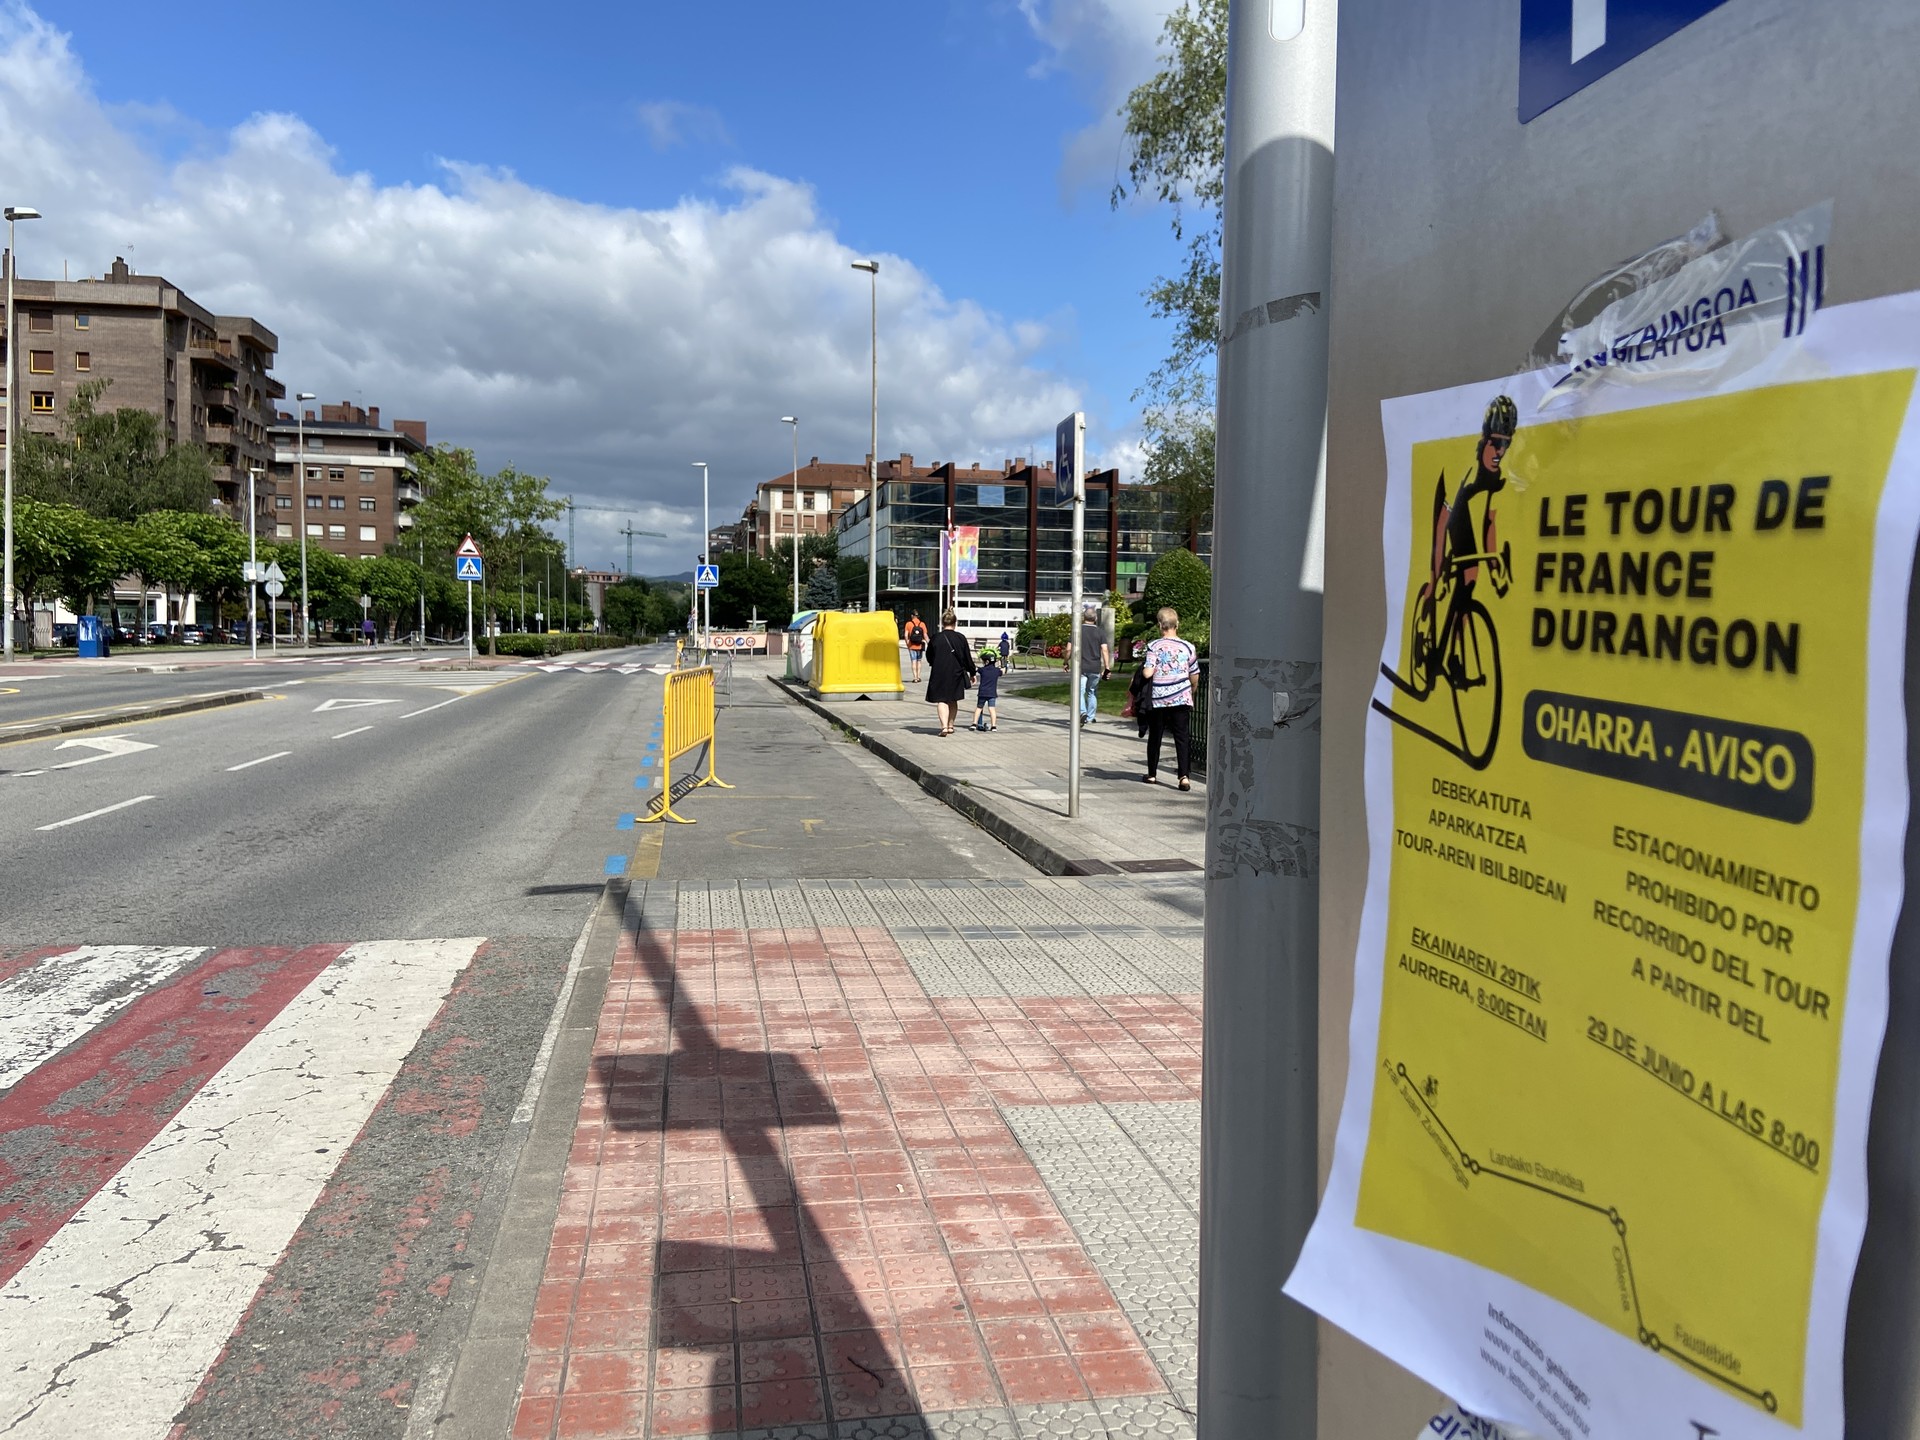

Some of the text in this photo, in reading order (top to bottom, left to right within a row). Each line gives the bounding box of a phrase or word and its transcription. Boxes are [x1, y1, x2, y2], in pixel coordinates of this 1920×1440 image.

[1539, 475, 1831, 537] LE TOUR DE
[1534, 550, 1715, 599] FRANCE
[1531, 608, 1800, 675] DURANGON
[1535, 703, 1797, 791] OHARRA AVISO
[1428, 808, 1527, 854] APARKATZEA
[1432, 777, 1532, 820] DEBEKATUTA
[1396, 829, 1567, 904] TOUR-AREN IBILBIDEAN
[1613, 825, 1820, 912] ESTACIONAMIENTO
[1626, 870, 1795, 954] PROHIBIDO POR
[1412, 926, 1541, 1000] EKAINAREN 29TIK
[1593, 900, 1830, 1020] RECORRIDO DEL TOUR
[1476, 987, 1547, 1039] 8:00ETAN
[1631, 957, 1771, 1044] A PARTIR DEL
[1587, 1016, 1820, 1168] 29 DE JUNIO A LAS 8:00
